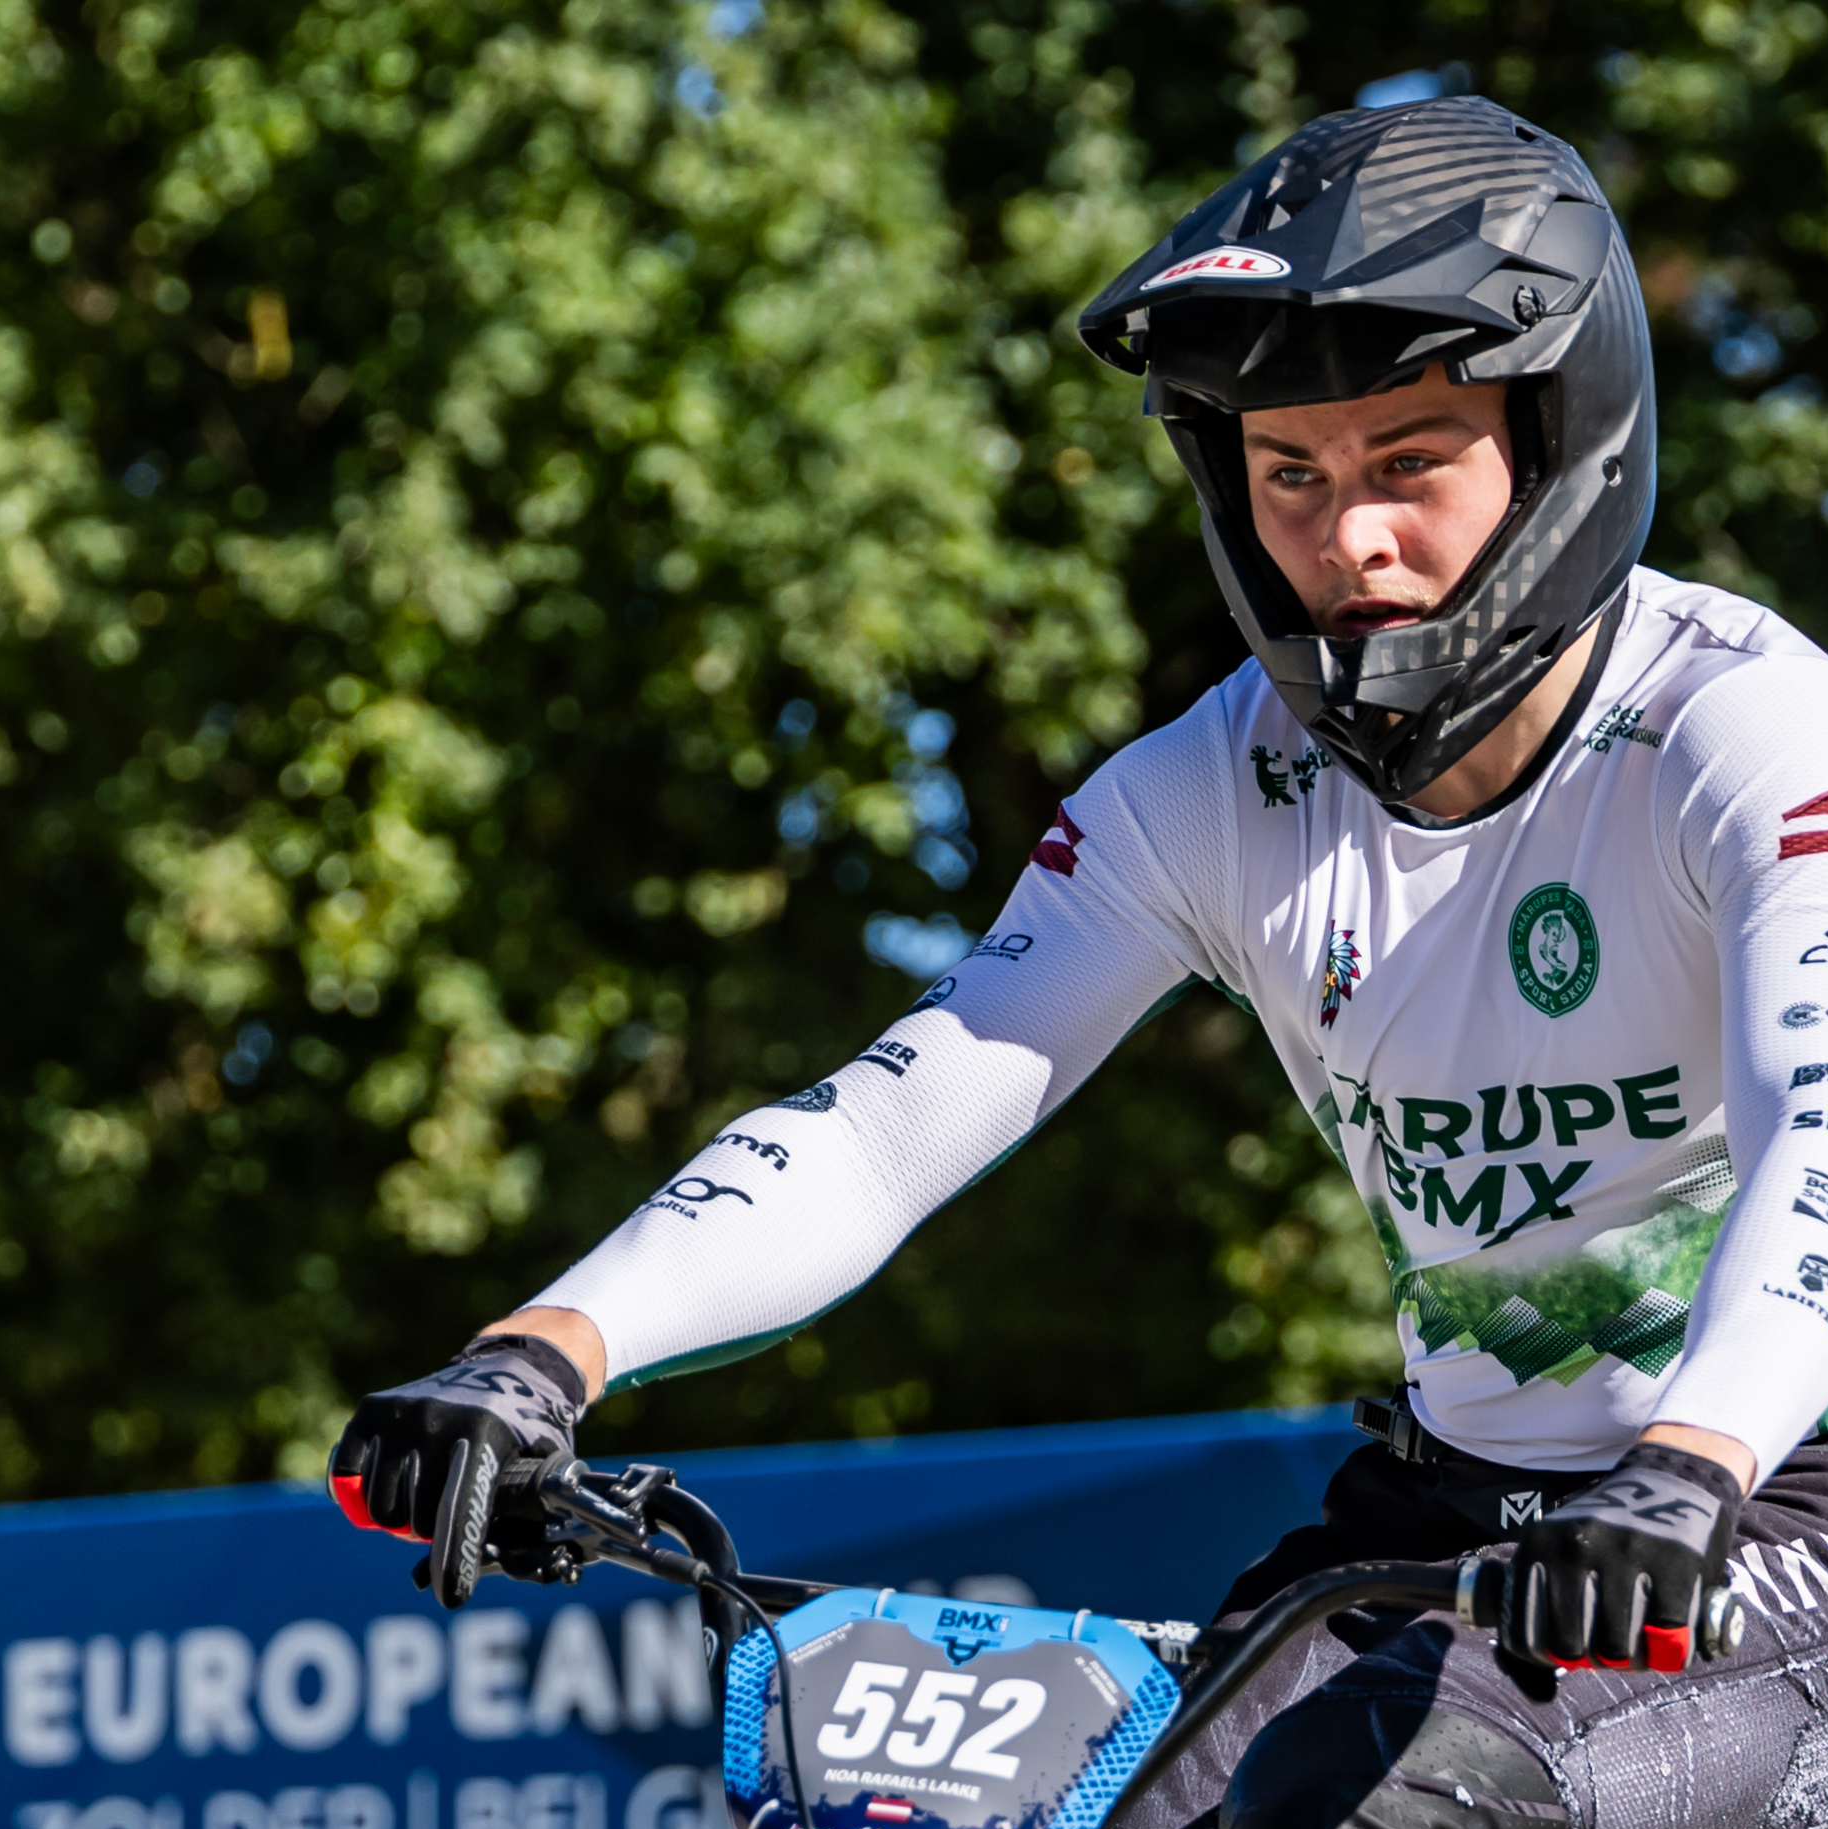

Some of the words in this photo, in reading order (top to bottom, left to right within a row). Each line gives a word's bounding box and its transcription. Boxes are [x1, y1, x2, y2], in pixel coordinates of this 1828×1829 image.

[1161, 255, 1259, 281] BELL
[937, 1607, 1001, 1632] BMX
[3, 1596, 715, 1767] EUROPEAN
[816, 1661, 1047, 1780] 552
[824, 1768, 859, 1784] NOA
[860, 1771, 928, 1791] RAFAELS
[928, 1779, 981, 1802] LAAKE
